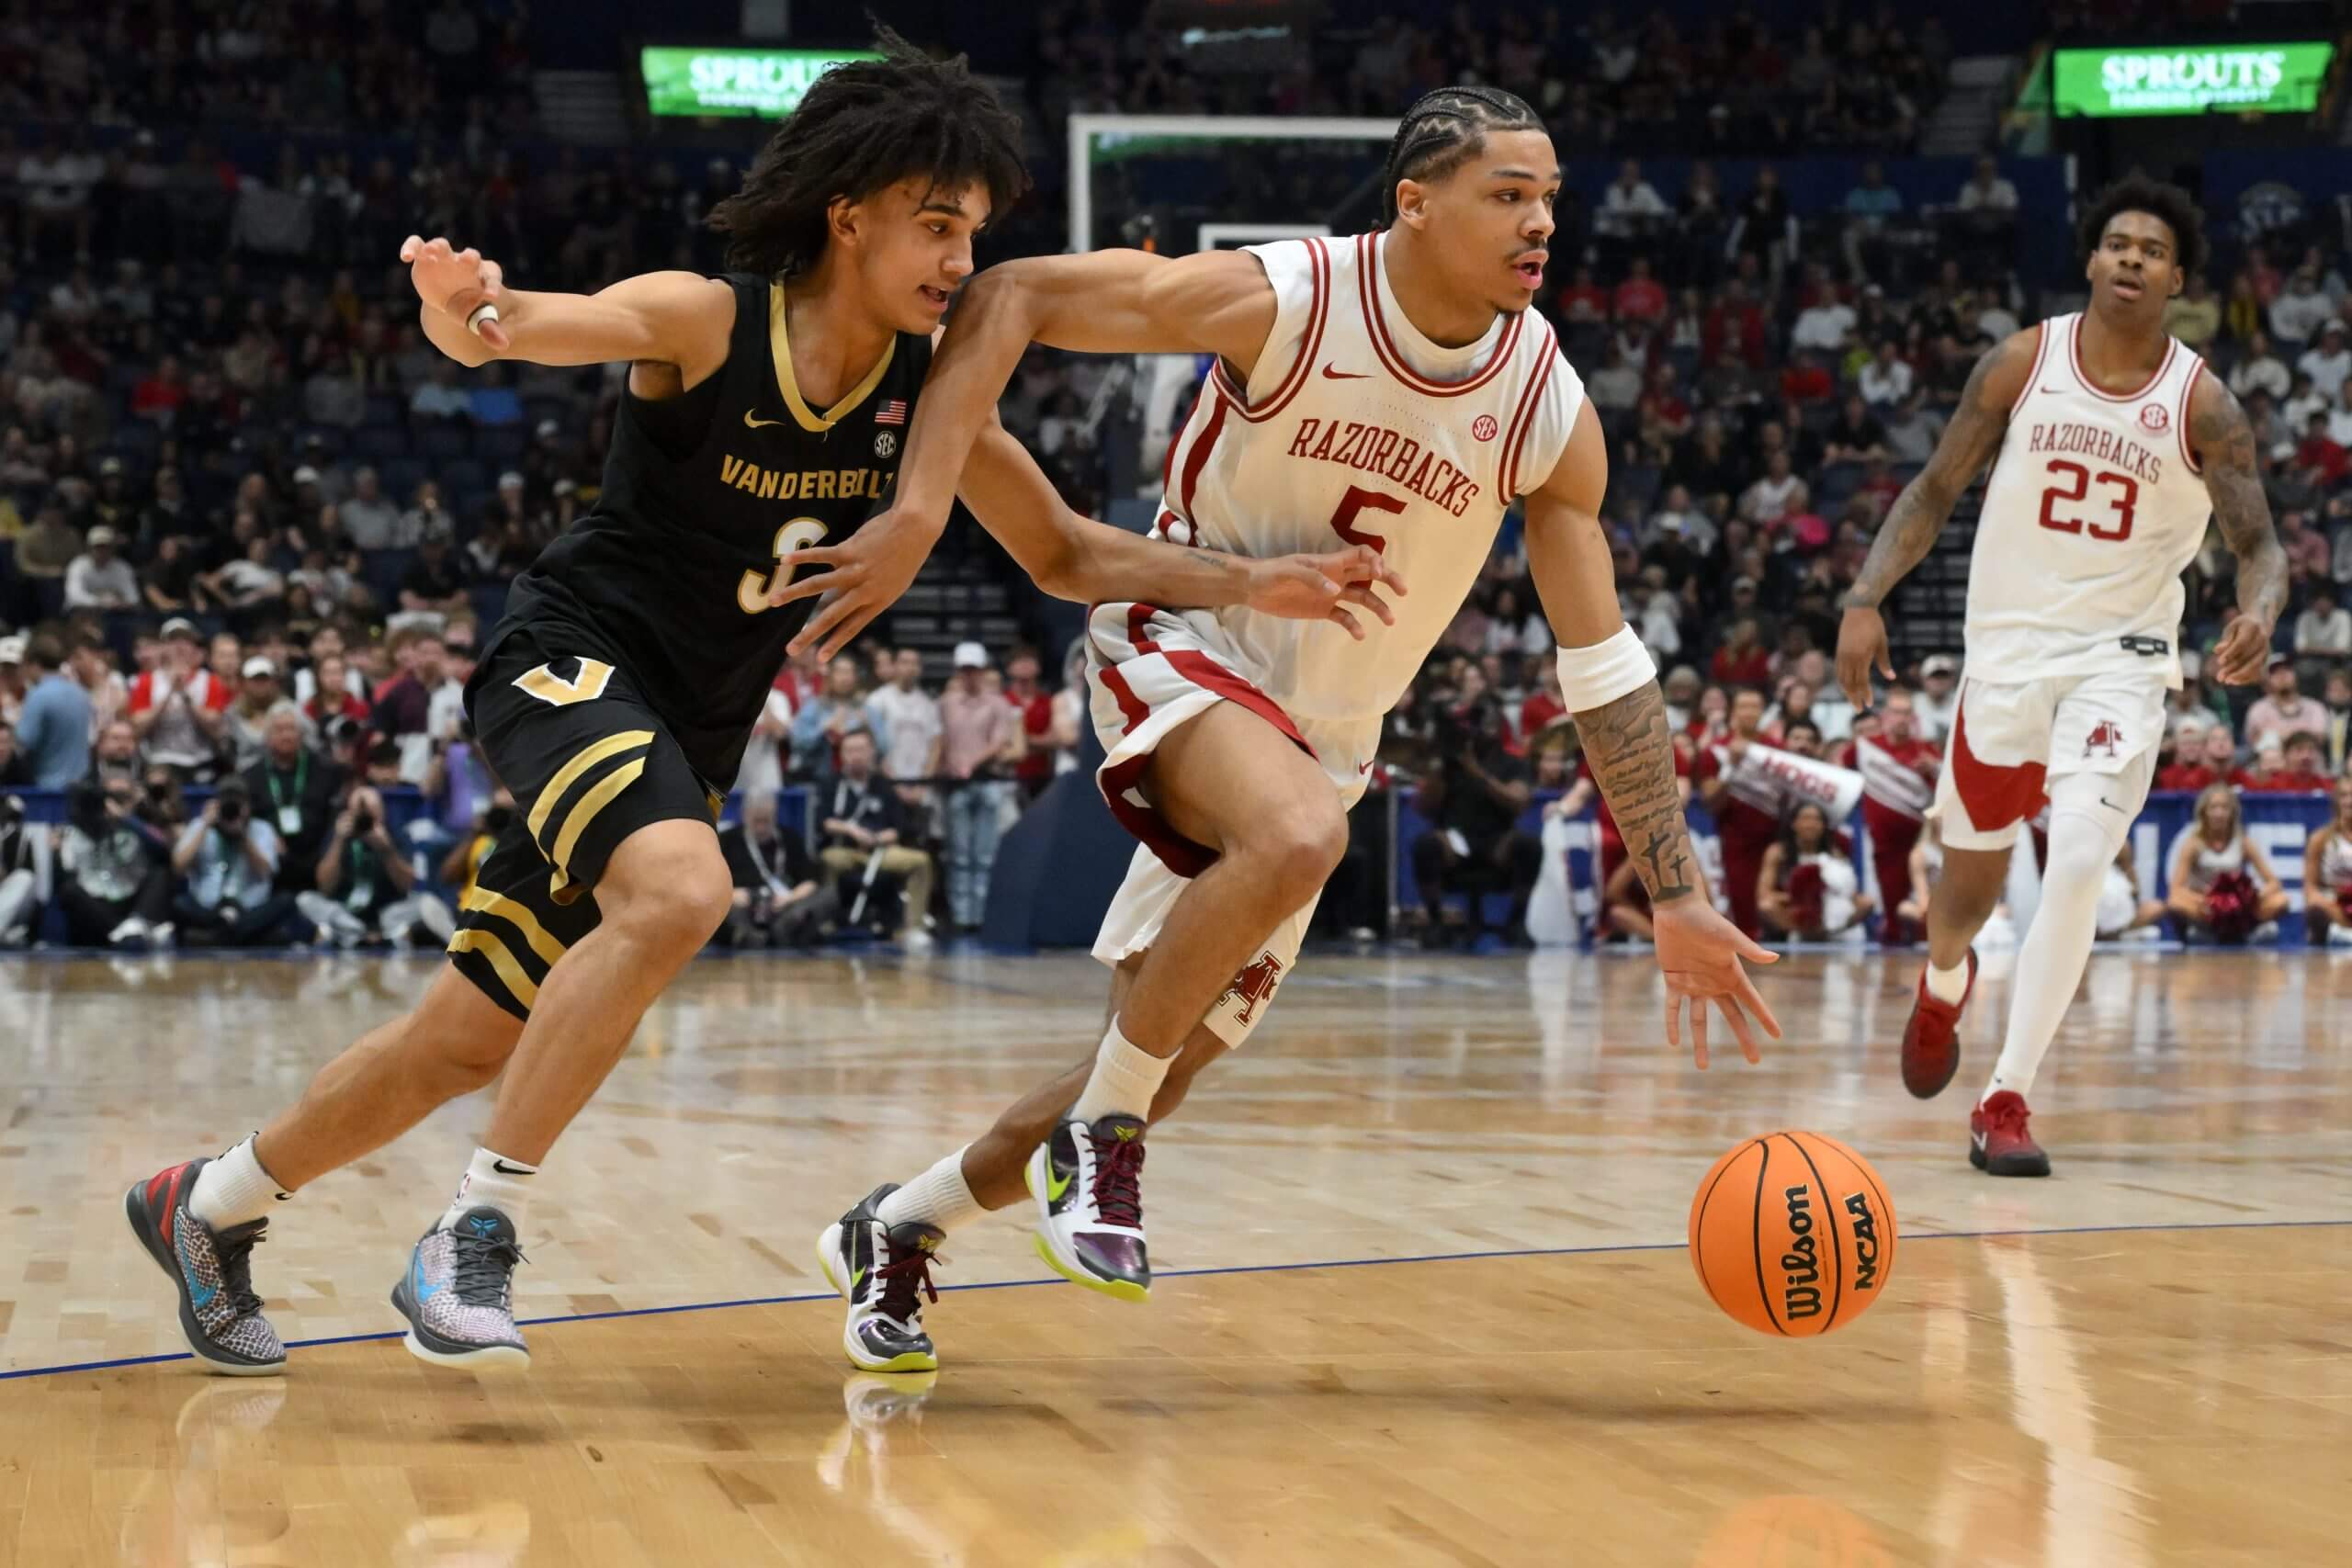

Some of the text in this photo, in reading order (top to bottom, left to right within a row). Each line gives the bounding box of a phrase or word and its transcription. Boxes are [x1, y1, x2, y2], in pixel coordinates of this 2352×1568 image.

[690, 57, 840, 92] SPROU
[2101, 52, 2284, 90] SPROUTS
[876, 432, 895, 457] SEC
[1473, 415, 1497, 441] SEC
[2030, 423, 2162, 485] RAZORBACKS
[1287, 419, 1479, 517] RAZORBACKS
[2039, 459, 2139, 542] 23
[1330, 485, 1408, 591] 5
[1781, 1183, 1823, 1321] Wilson
[1844, 1191, 1879, 1291] NCAA
